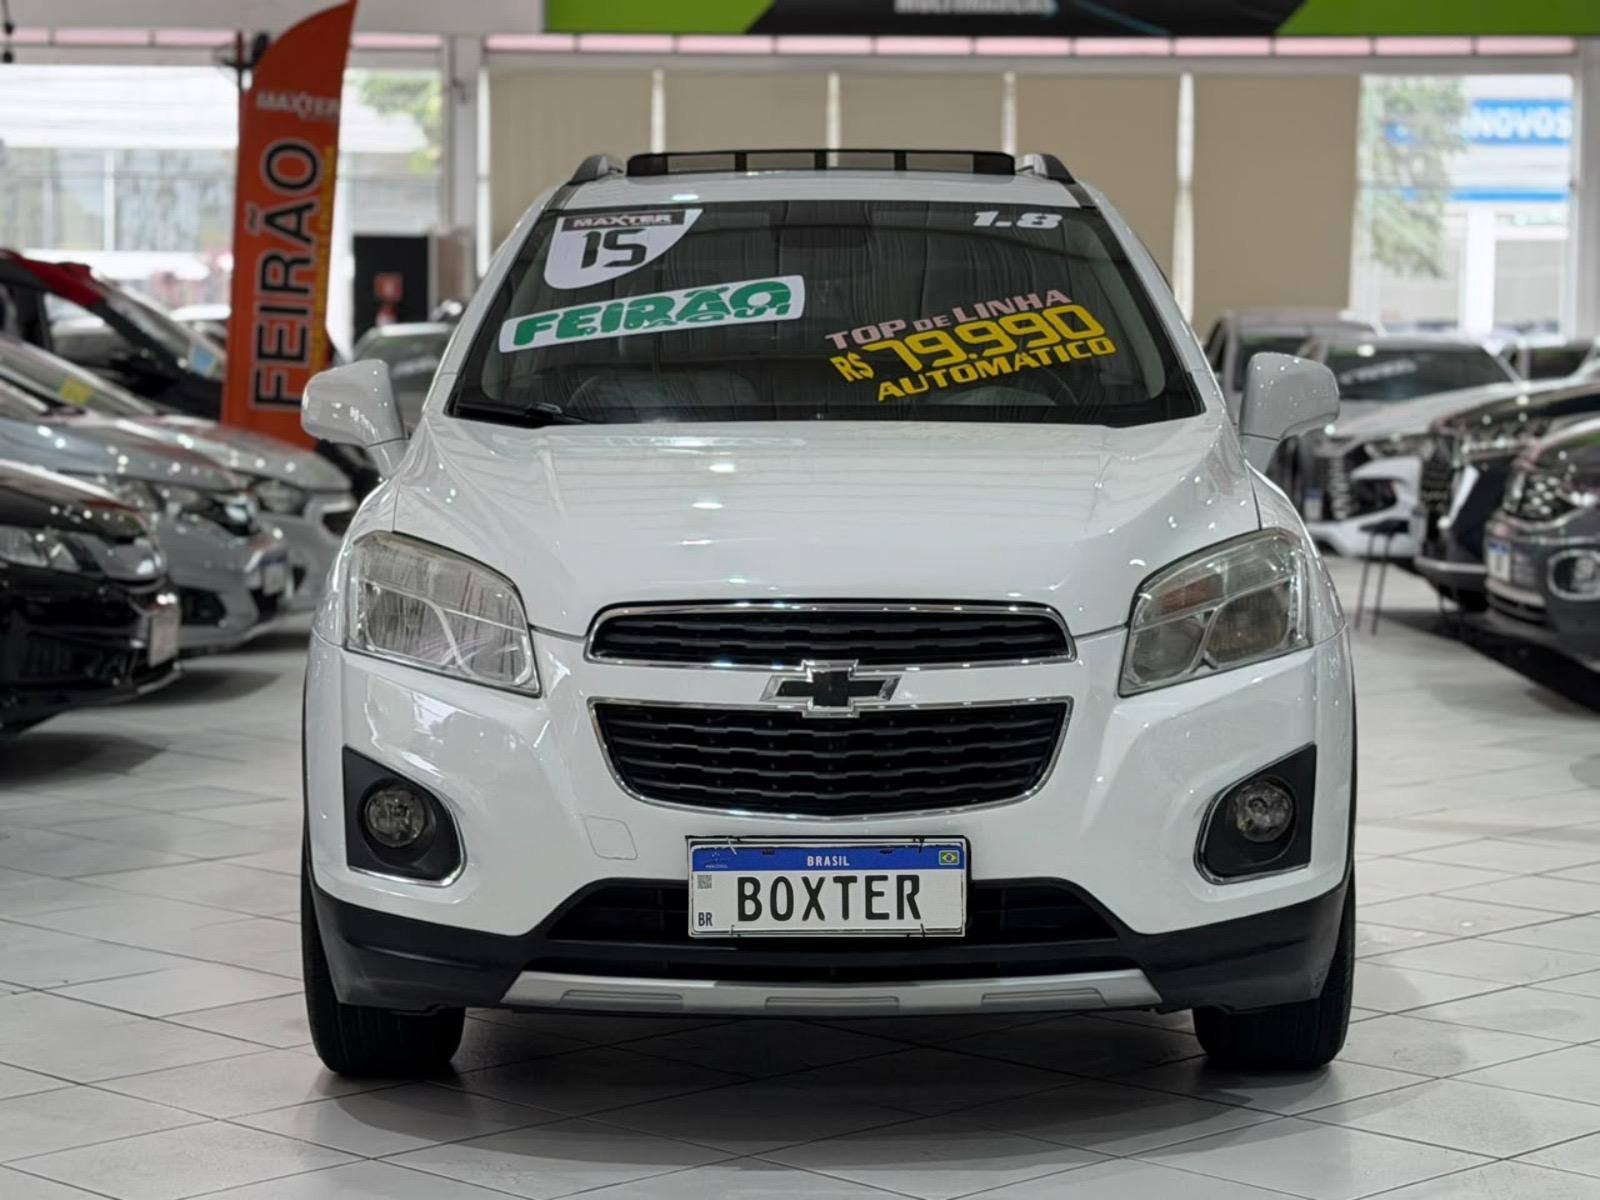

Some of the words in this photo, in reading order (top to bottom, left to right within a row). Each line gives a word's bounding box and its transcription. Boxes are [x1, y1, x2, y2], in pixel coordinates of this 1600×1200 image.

[573, 214, 673, 228] MAXTER
[972, 210, 1063, 230] 1.8
[581, 228, 648, 270] 15
[246, 139, 323, 410] FEIRÃO
[512, 281, 792, 346] FEIRÃO
[825, 319, 906, 350] TOP
[911, 314, 952, 332] DE
[952, 289, 1073, 324] LINHA
[861, 304, 1106, 373] 79.990
[807, 855, 850, 867] BRASIL
[697, 911, 713, 927] BR
[736, 874, 923, 922] BOXTER
